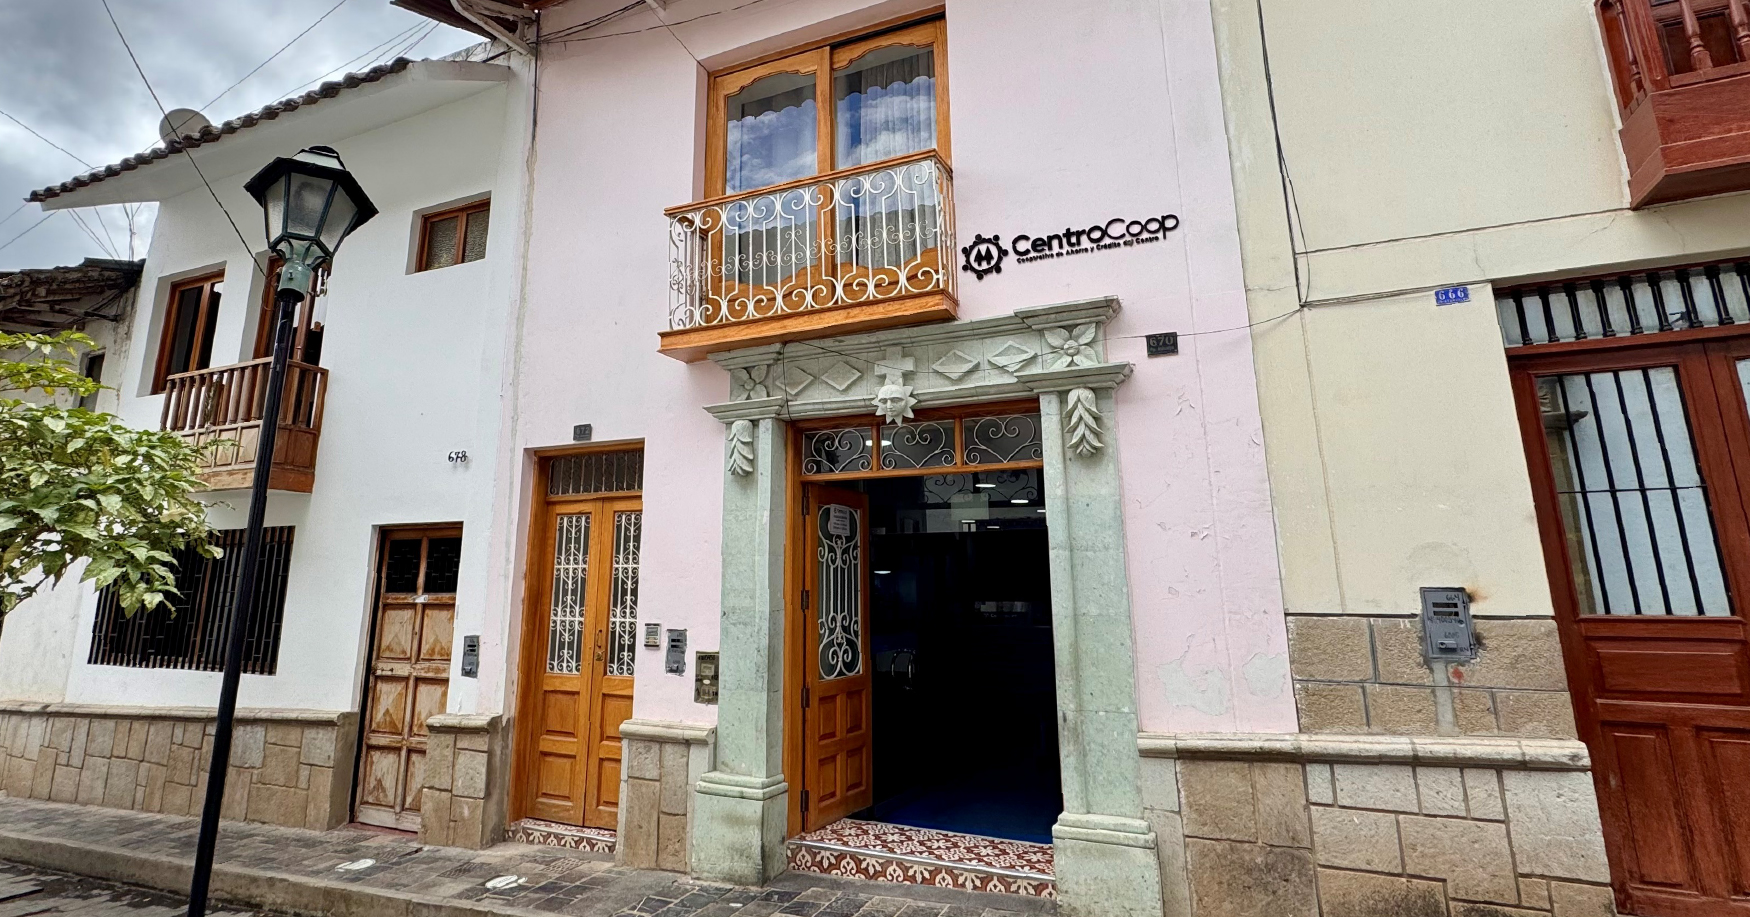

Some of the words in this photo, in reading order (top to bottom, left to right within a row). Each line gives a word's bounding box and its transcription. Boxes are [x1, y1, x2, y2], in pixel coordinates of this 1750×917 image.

[1012, 213, 1179, 257] CentroCoop
[1066, 247, 1089, 256] Ahorro
[1135, 236, 1160, 244] Centro
[1438, 288, 1465, 300] 666
[1149, 335, 1174, 347] 670
[448, 450, 468, 463] 678
